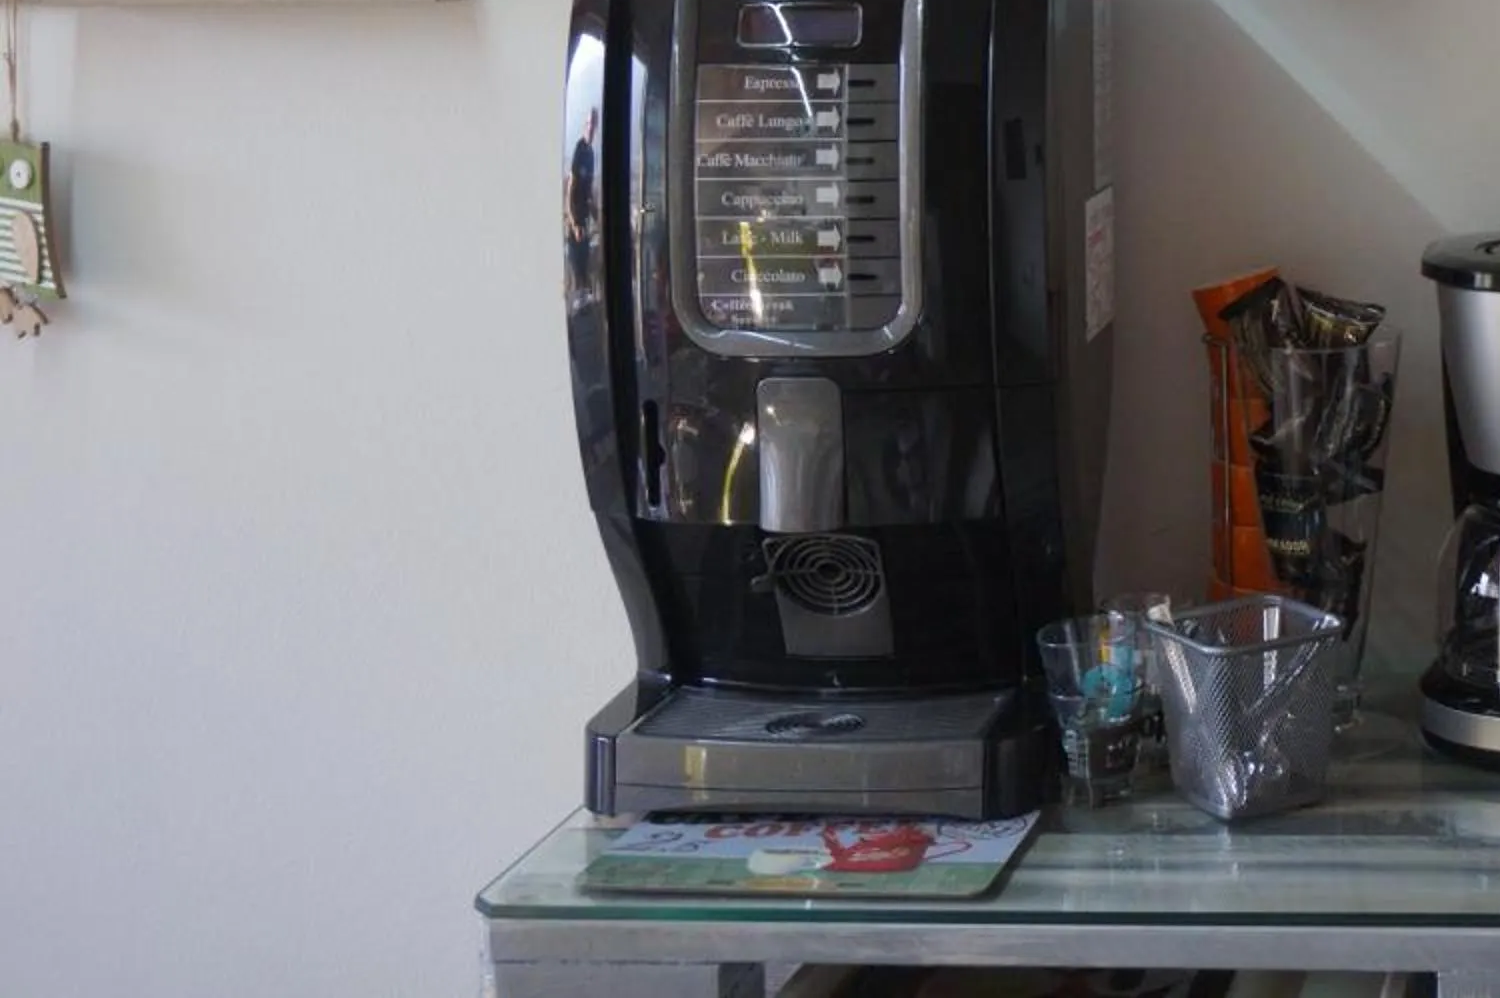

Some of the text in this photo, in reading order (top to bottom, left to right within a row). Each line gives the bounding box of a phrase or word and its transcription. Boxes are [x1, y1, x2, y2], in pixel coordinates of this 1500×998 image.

[744, 75, 805, 94] Espress
[716, 113, 804, 132] Caffè Lungo
[697, 154, 732, 167] Caffè
[721, 191, 804, 211] Cappuccino
[722, 231, 757, 245] Lae
[770, 230, 803, 244] Milk
[731, 268, 806, 283] Ciccolato
